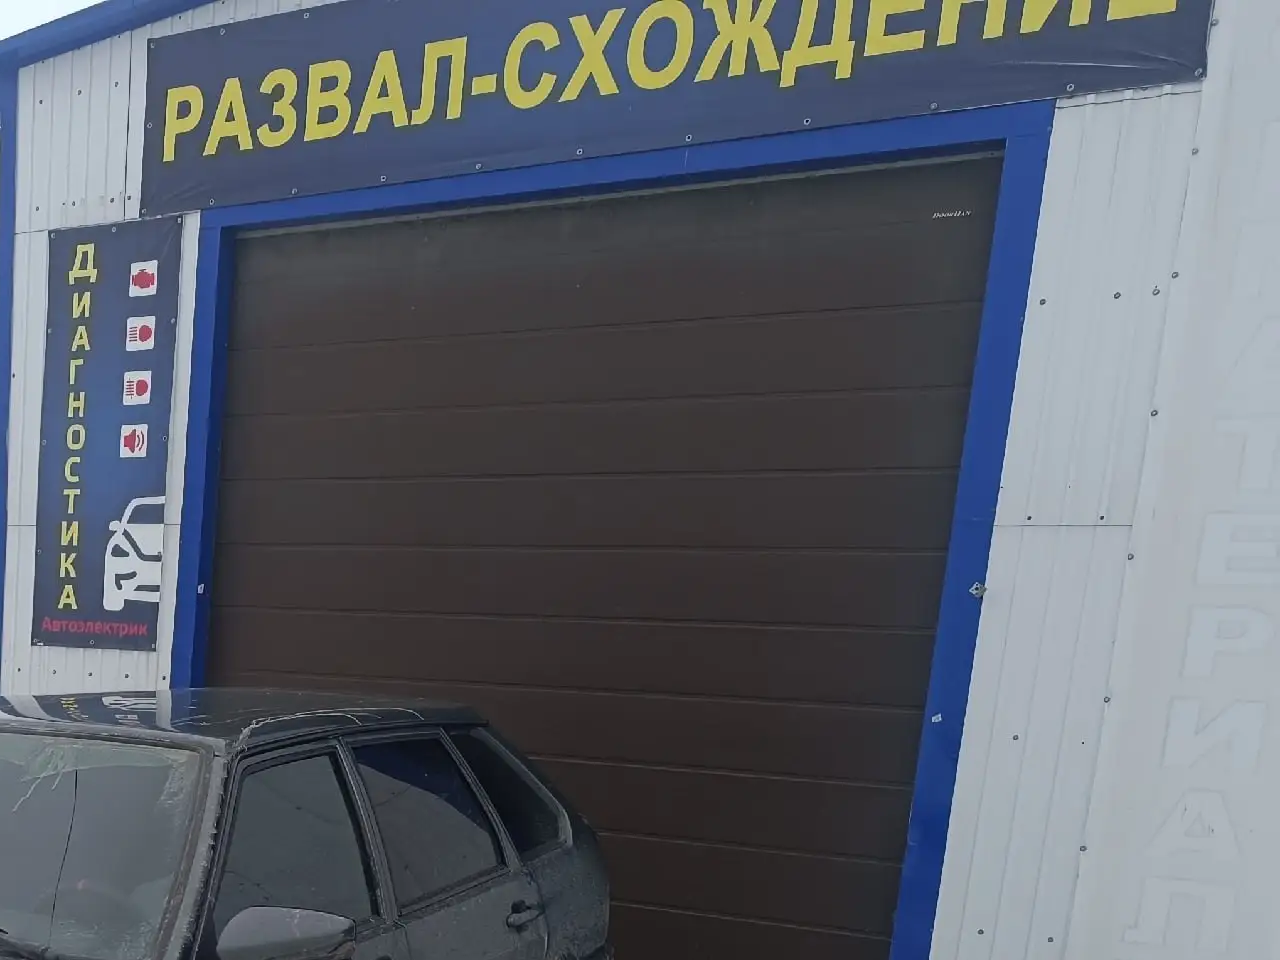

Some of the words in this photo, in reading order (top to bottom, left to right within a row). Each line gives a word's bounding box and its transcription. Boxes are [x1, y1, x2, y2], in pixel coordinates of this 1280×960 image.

[161, 0, 1178, 163] РАЗВАЛ-СХОЖДЕН
[56, 242, 99, 611] ДИАГНОСТИКА
[40, 616, 148, 638] Автоэлектрик
